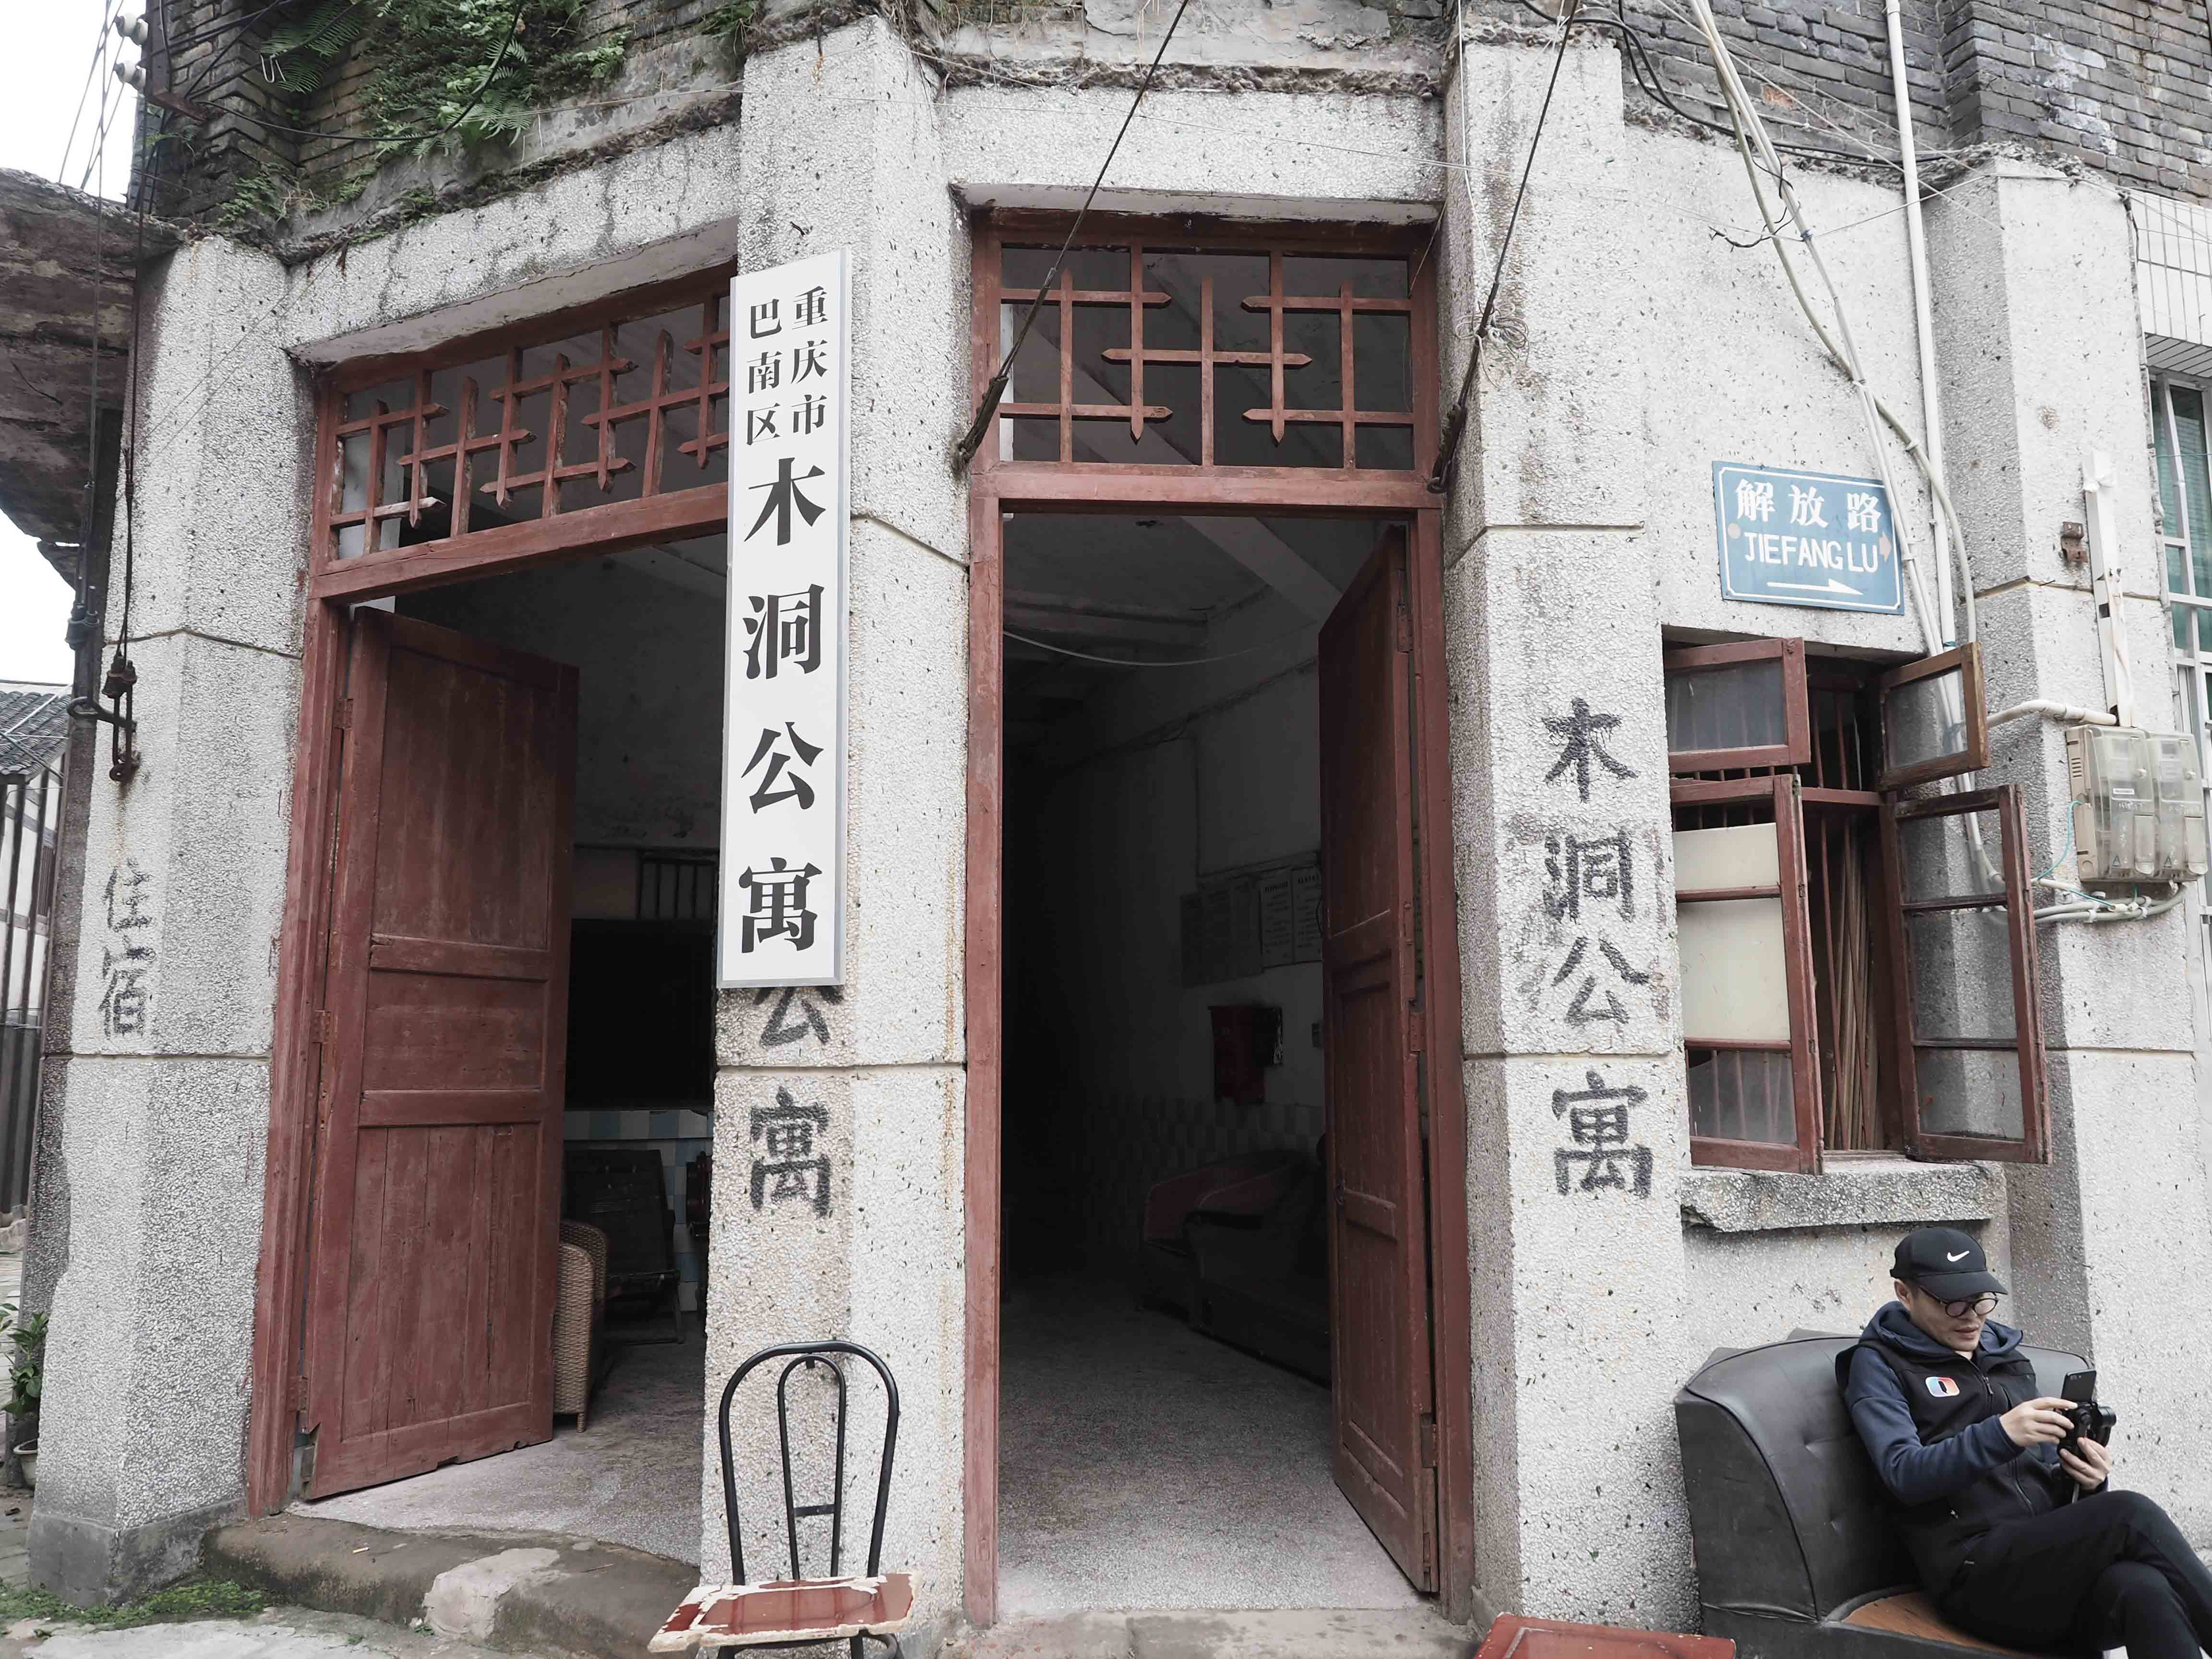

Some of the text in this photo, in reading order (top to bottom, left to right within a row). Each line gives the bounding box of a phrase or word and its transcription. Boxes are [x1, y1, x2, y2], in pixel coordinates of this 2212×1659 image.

[746, 299, 783, 446] 巴南区
[791, 286, 829, 434] 重庆市
[1735, 478, 1882, 533] 解放路
[739, 457, 827, 955] 木洞公寓
[1541, 697, 1654, 1199] 木洞公寓
